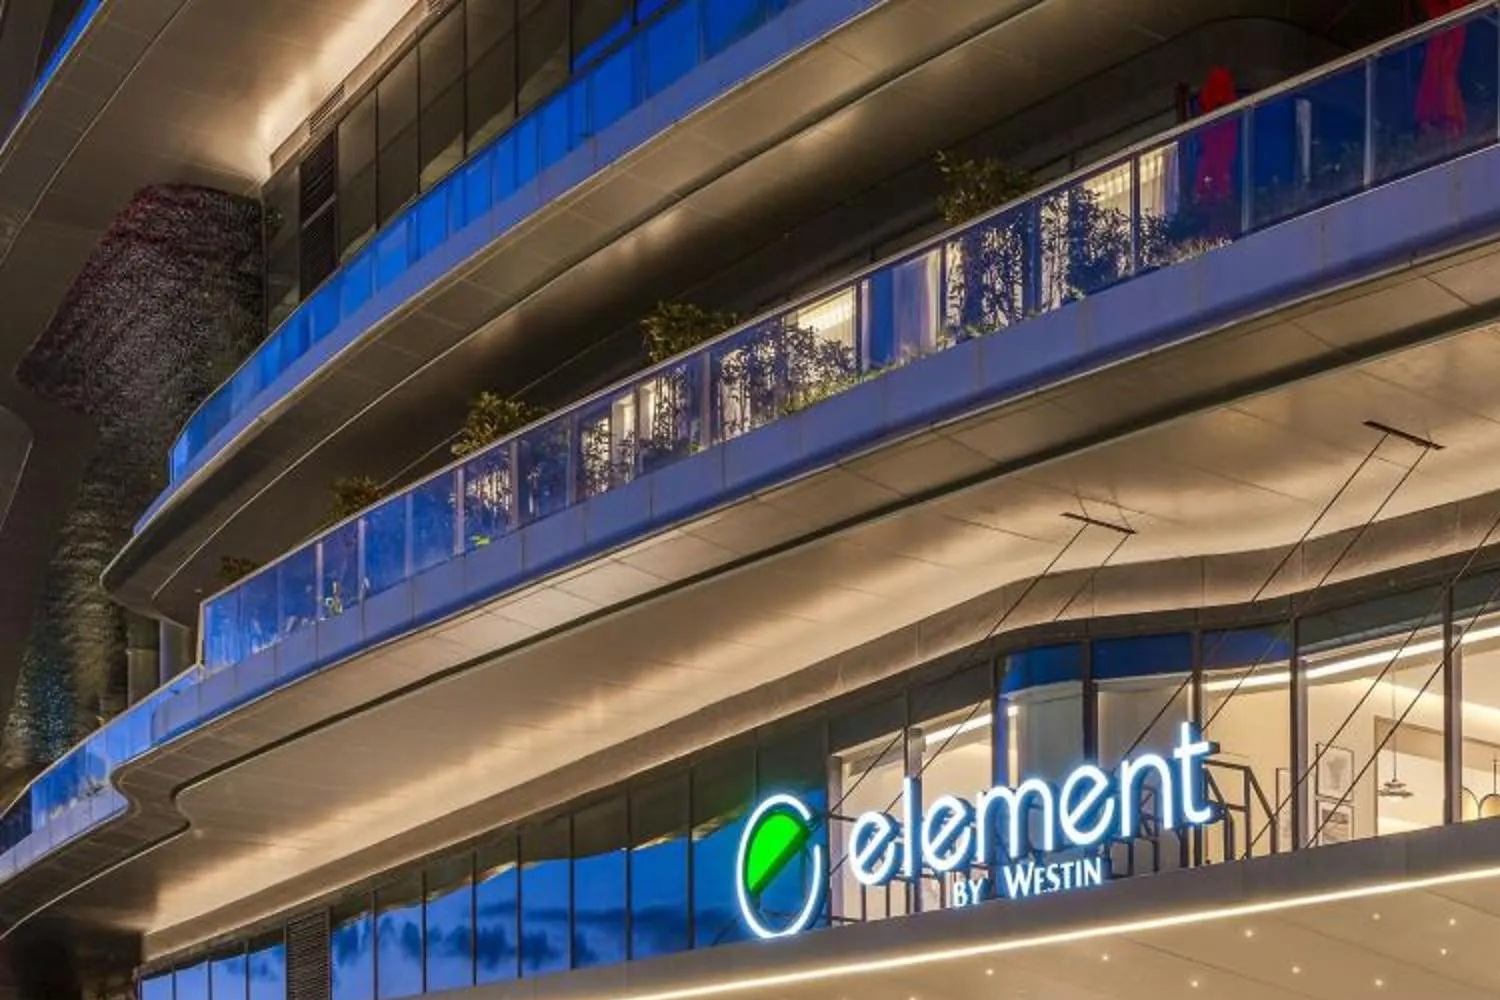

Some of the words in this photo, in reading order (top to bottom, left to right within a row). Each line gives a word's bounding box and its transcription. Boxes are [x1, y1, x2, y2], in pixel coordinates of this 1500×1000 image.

[848, 721, 1212, 886] element
[952, 880, 984, 908] BY
[1003, 856, 1102, 899] WESTIN
